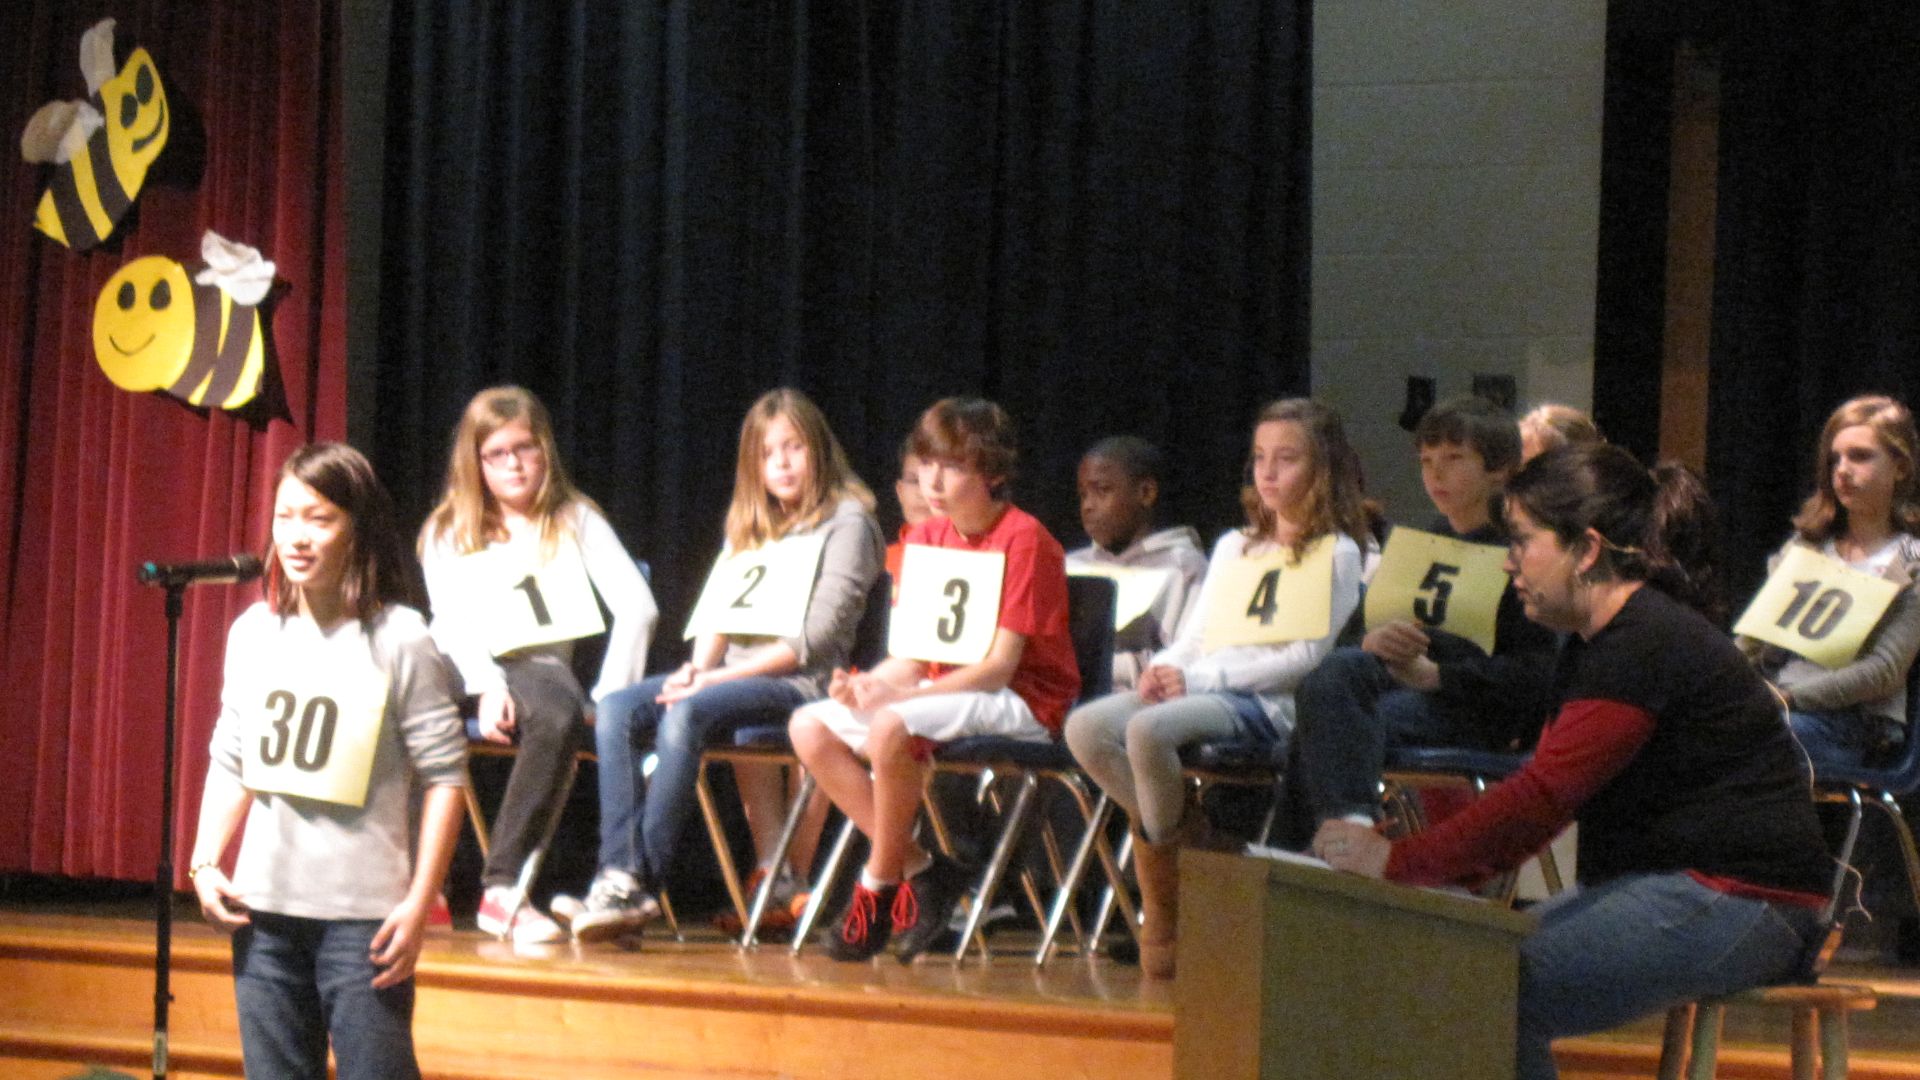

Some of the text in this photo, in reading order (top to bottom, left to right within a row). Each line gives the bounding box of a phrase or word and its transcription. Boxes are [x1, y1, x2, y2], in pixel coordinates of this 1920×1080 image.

[514, 574, 552, 626] 1
[731, 564, 767, 609] 2
[937, 578, 970, 643] 3
[1247, 569, 1281, 625] 4
[1414, 562, 1460, 627] 5
[1775, 579, 1854, 640] 10
[259, 690, 338, 772] 30
